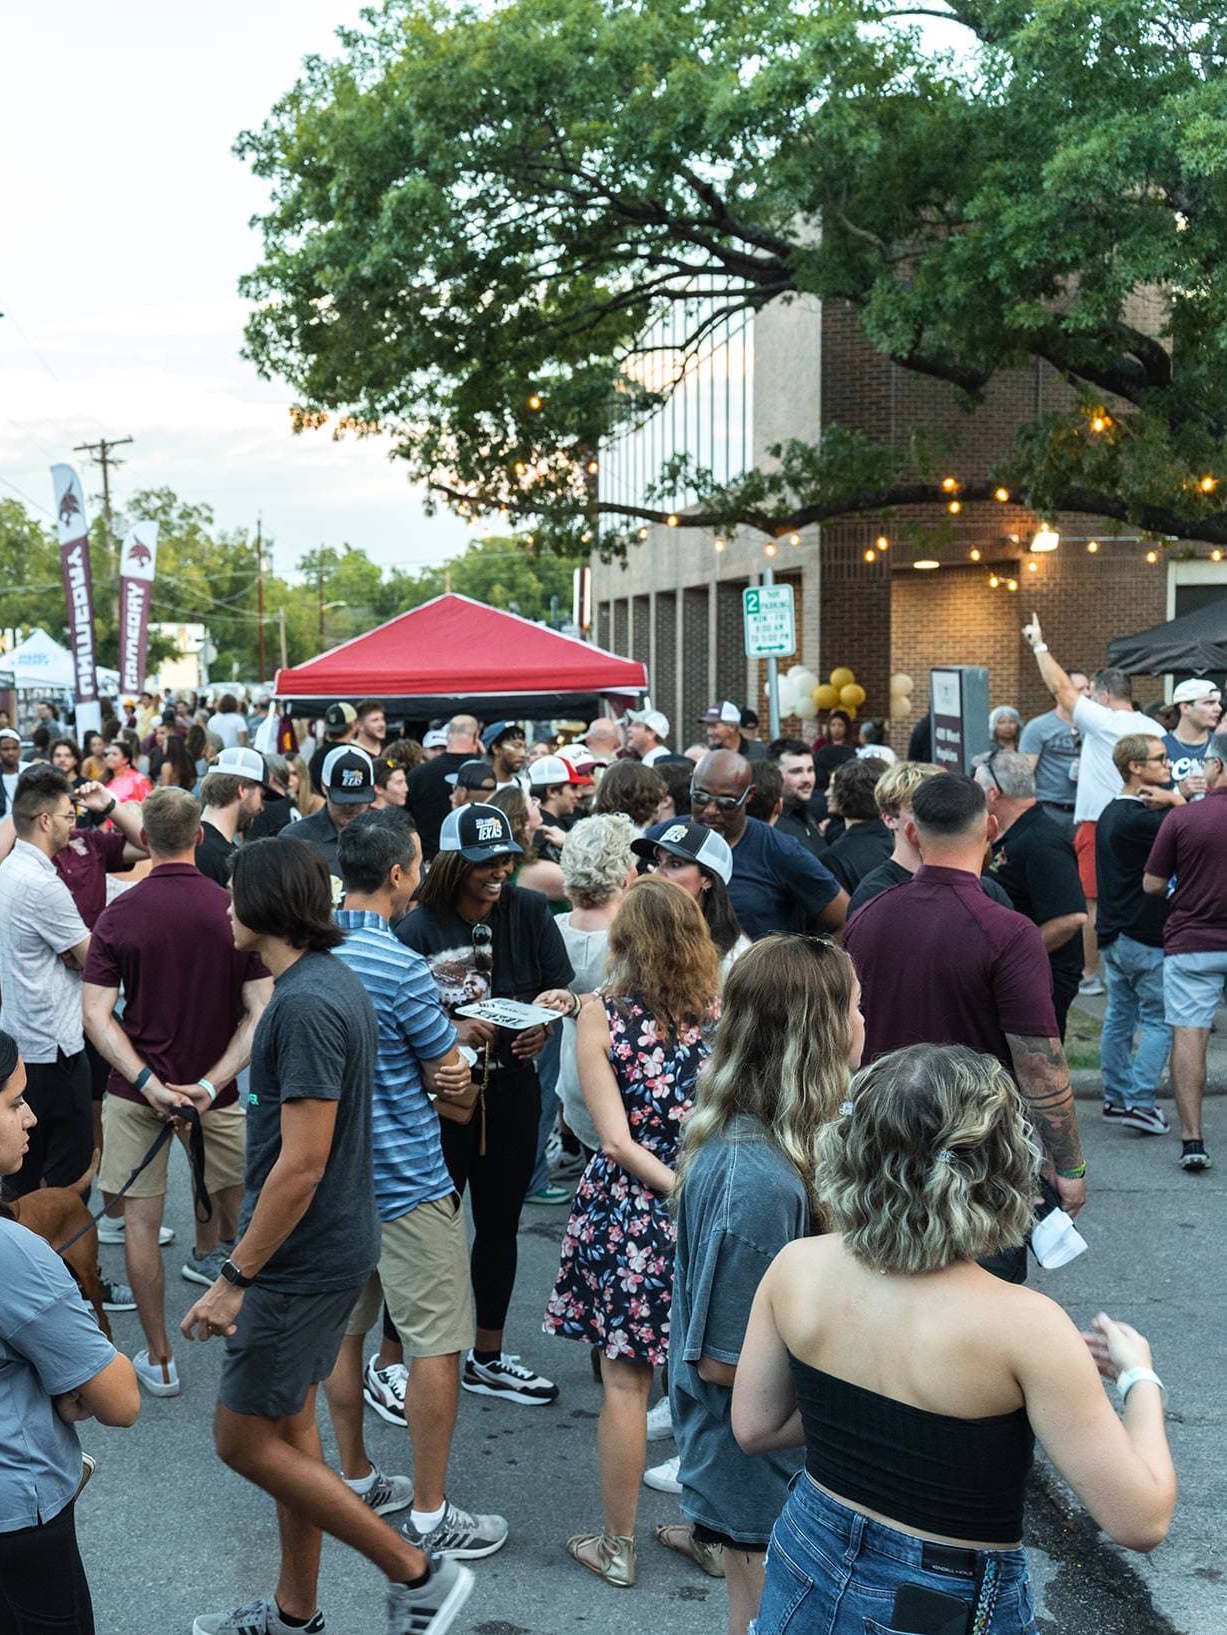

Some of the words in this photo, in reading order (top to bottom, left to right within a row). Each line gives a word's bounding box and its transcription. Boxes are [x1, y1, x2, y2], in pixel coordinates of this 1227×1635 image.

[747, 593, 758, 611] 2
[123, 581, 145, 690] GAMEDAY
[476, 823, 503, 841] TEXAS
